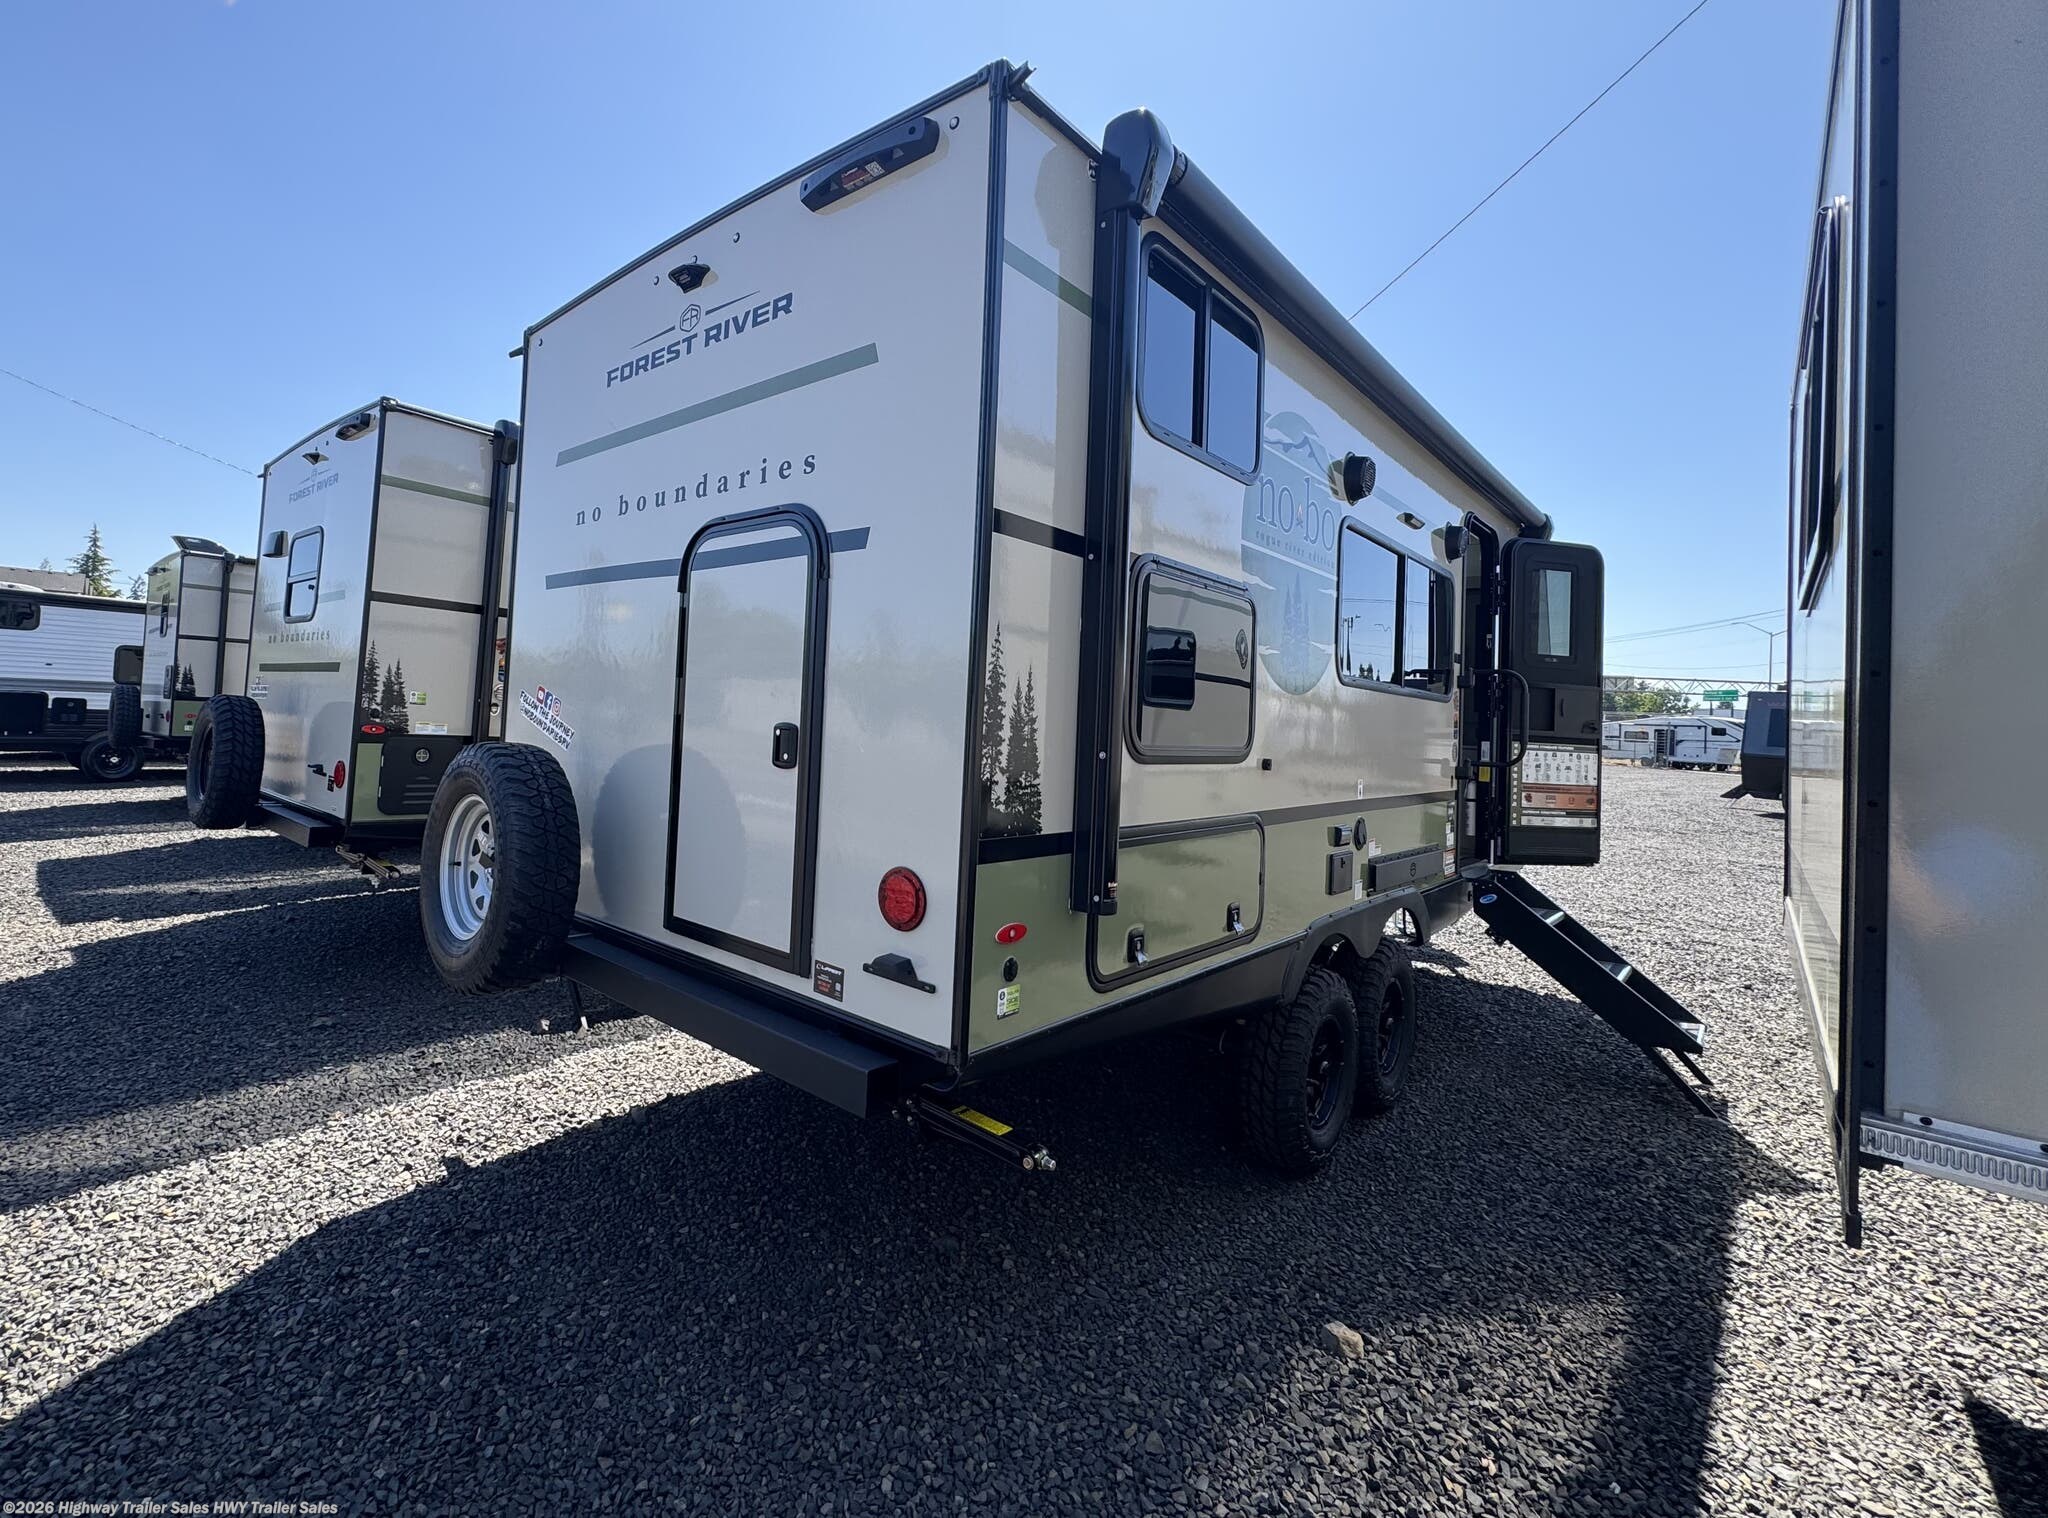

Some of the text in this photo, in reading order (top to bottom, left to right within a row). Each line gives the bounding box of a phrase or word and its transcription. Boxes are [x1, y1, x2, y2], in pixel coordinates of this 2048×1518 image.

[606, 292, 793, 388] FOREST RIVER
[289, 472, 339, 504] FOREST RIVER
[575, 454, 816, 526] no boundaries
[281, 629, 331, 643] boundaries
[520, 690, 575, 740] FOLLOW THE JOURNEY
